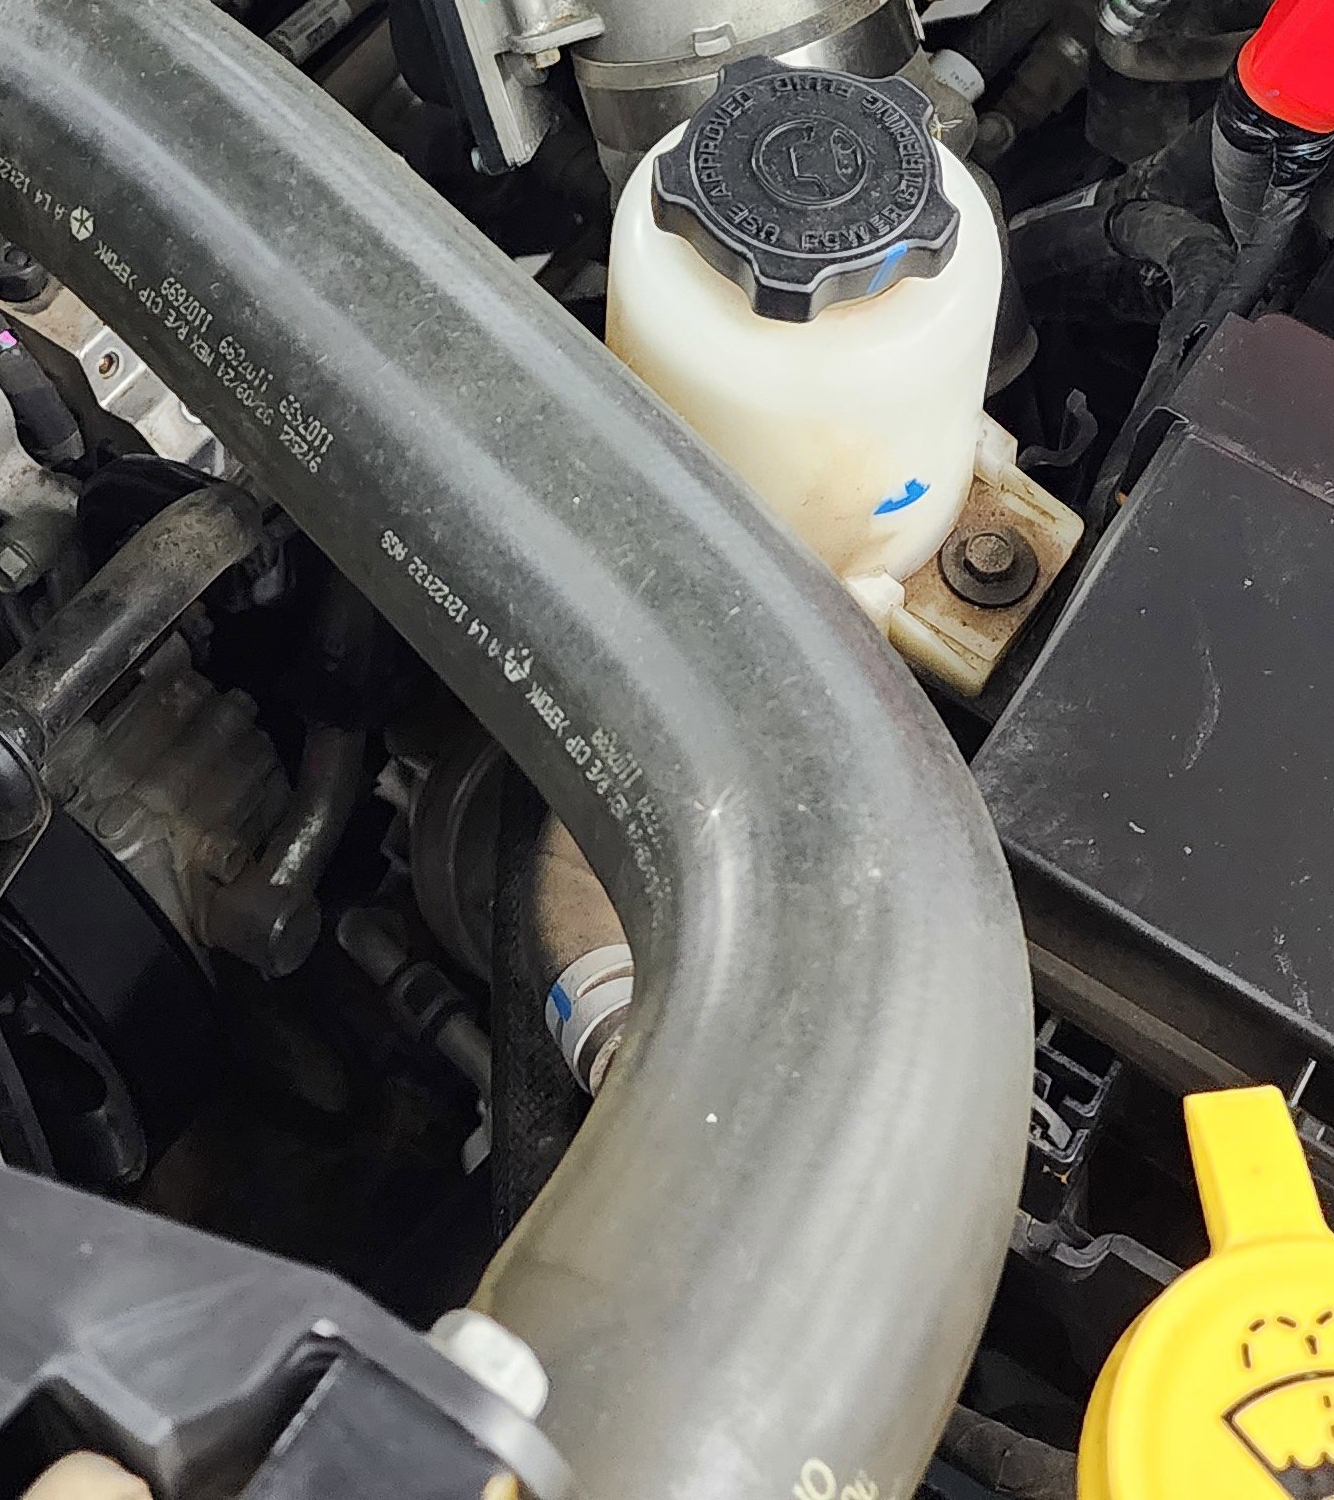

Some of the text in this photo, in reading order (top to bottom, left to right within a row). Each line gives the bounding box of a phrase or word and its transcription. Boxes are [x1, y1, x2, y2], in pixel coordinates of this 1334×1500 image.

[698, 90, 781, 244] USE APPROVED
[774, 75, 924, 251] POWER STEERING FLUID
[35, 189, 51, 211] L4
[138, 287, 163, 314] CIP
[164, 309, 189, 340] R/E
[190, 334, 216, 367] MEX
